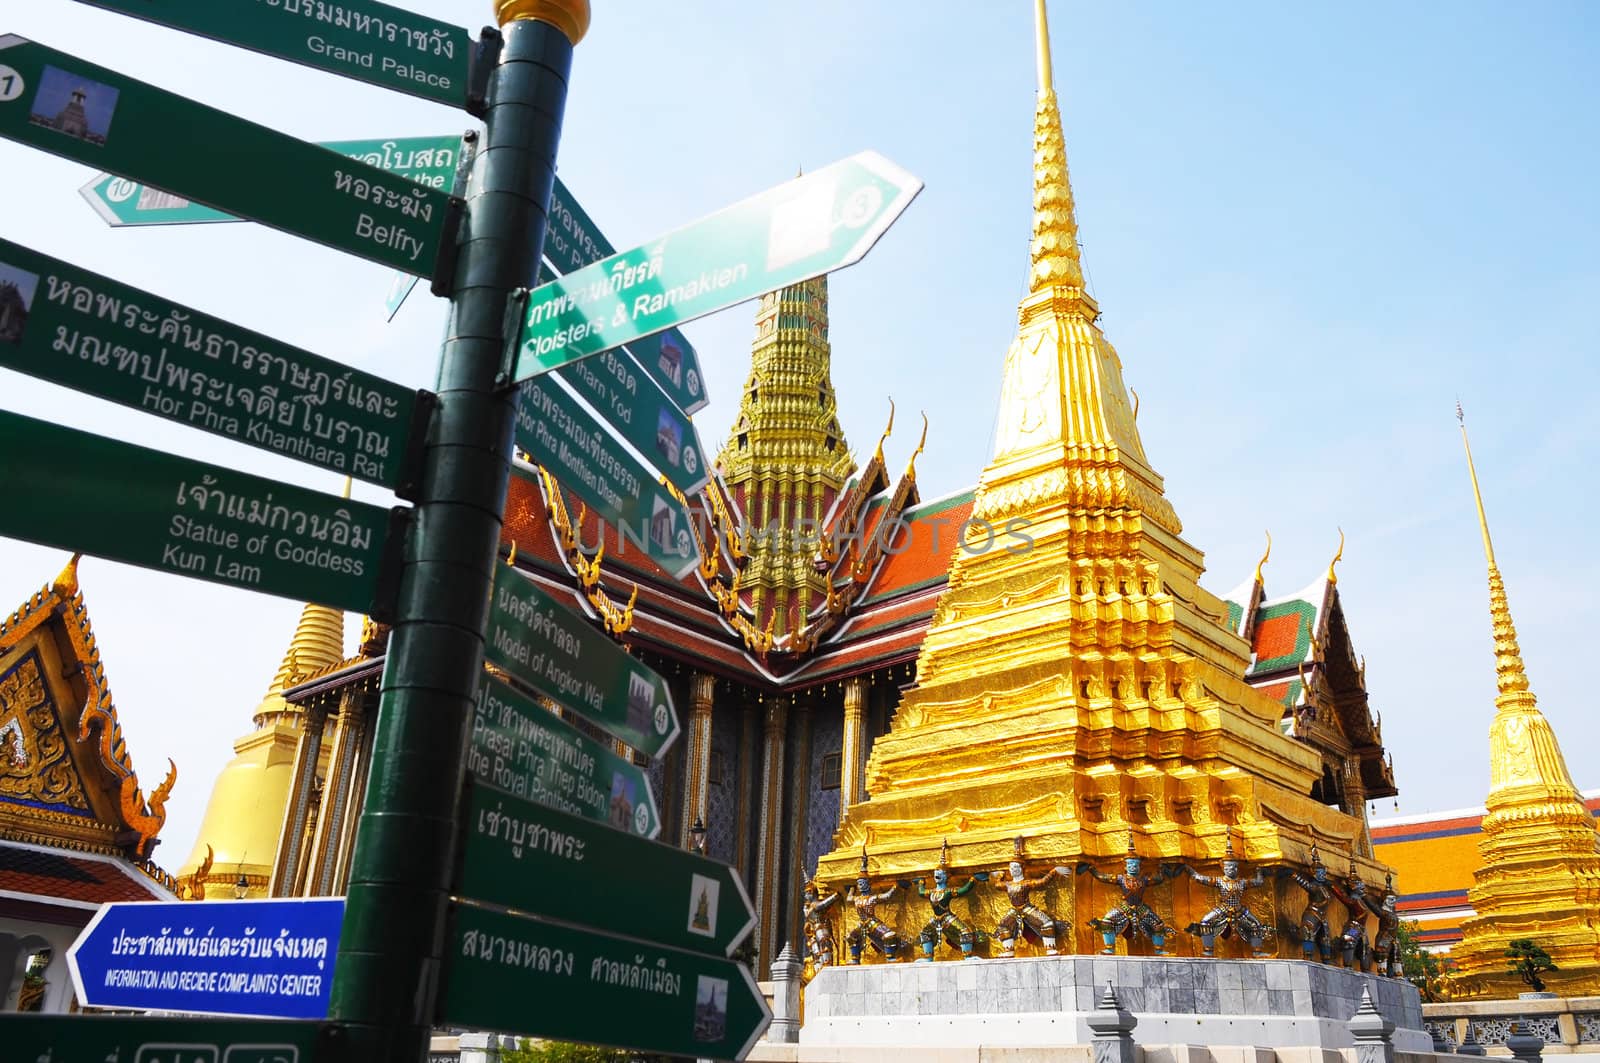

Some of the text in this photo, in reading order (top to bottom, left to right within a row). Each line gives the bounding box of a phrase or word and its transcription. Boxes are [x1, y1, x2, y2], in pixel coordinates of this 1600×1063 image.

[264, 0, 454, 59] บรมมหาราชวัง
[307, 36, 451, 89] Grand Palace
[113, 180, 133, 197] 10
[334, 170, 433, 223] หอระฆัง
[355, 213, 424, 260] Belfry
[523, 262, 748, 359] Cloisters & Ramakien
[47, 275, 398, 418] หอพระคันธารราษฎร์และ
[53, 325, 390, 457] มณฑปพระเจดีย์โบราณ
[610, 388, 632, 424] Yod
[143, 386, 385, 480] Hor Phra Khanthara Rat
[516, 403, 623, 512] Hor Phra Monthien Dharm
[176, 474, 372, 550] เจ้าแม่กวนอิม
[162, 543, 261, 584] Kun Lam
[169, 514, 364, 577] Statue of Goddess
[499, 587, 581, 659] นครวัดจำลอง
[494, 624, 604, 711] Model of Angkor Wat
[467, 744, 490, 777] the
[492, 758, 530, 799] Royal
[472, 713, 513, 760] Prasat
[517, 739, 546, 777] Phra
[549, 757, 576, 798] Thep
[478, 802, 586, 861] เช่าบูชาพระ
[112, 926, 328, 971] ประชาสัมพันธ์และรับแจ้งเหตุ
[462, 929, 681, 996] สนามหลวง ศาลหลักเมือง
[104, 968, 322, 997] INFORMATION AND RECIEVE COMPLAINTS CENTER
